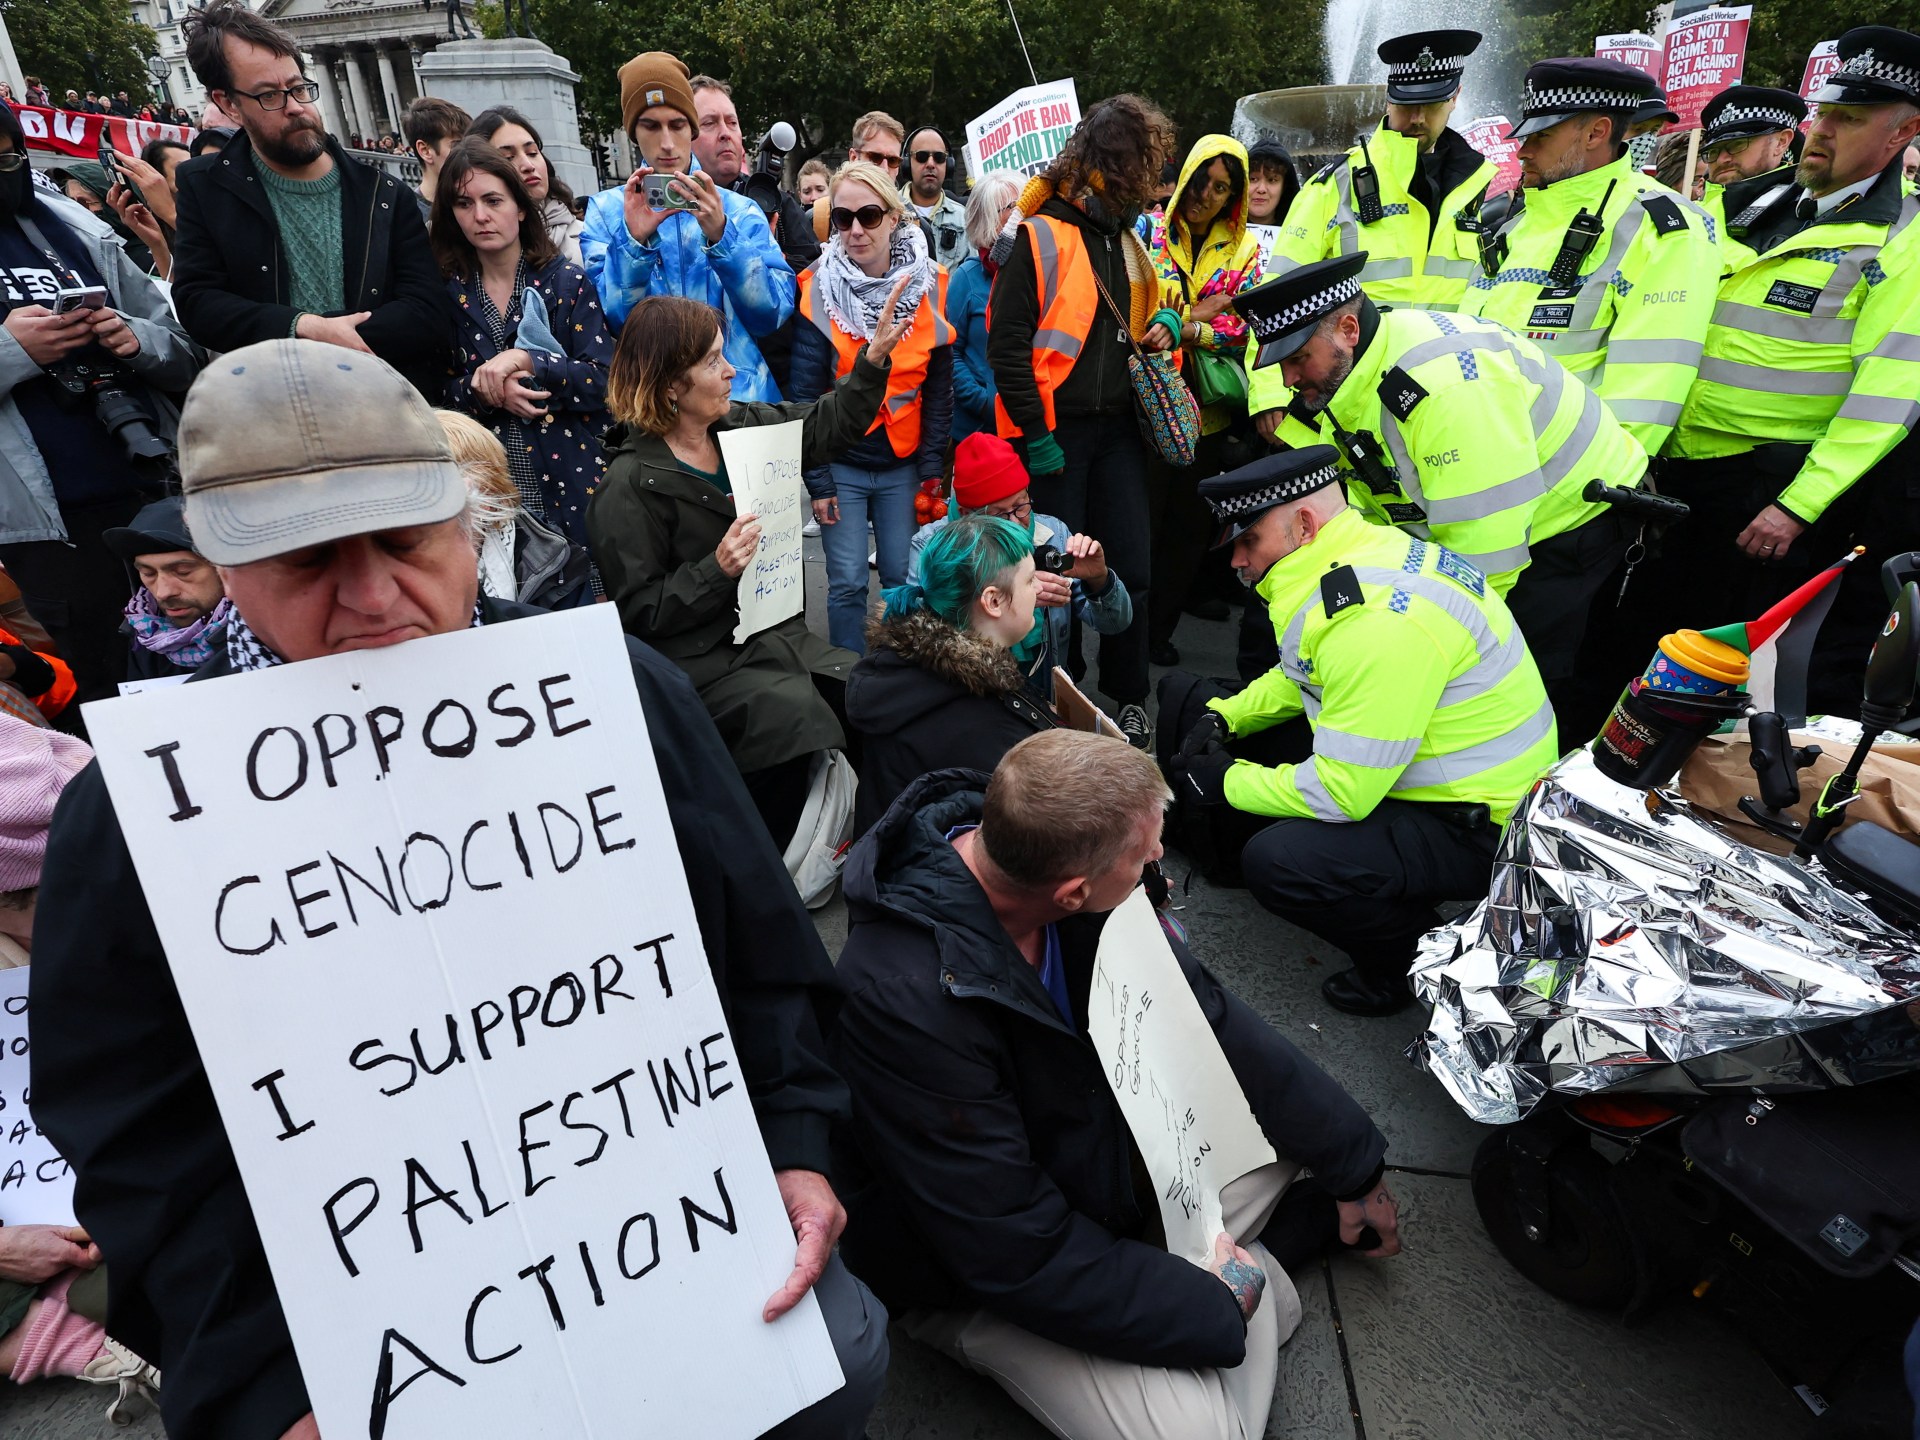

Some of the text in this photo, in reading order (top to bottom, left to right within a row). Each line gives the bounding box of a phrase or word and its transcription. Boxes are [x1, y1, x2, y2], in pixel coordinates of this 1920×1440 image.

[1679, 11, 1738, 28] Socialist Worker
[1609, 37, 1637, 47] Socialist
[1670, 23, 1729, 48] IT'S NOT A
[1624, 50, 1643, 67] NOT
[1643, 51, 1649, 67] A
[1669, 38, 1725, 63] CRIME TO
[1666, 61, 1692, 79] ACT
[1693, 53, 1738, 73] AGAINST
[1665, 69, 1722, 93] GENOCIDE
[1669, 90, 1713, 104] Free Palestine
[988, 93, 1067, 129] Stop the War coalition
[979, 121, 1012, 161] DROP
[1012, 109, 1039, 138] THE
[1039, 102, 1072, 129] BAN
[982, 132, 1043, 175] DEFEND
[1642, 290, 1687, 306] POLICE
[1768, 294, 1811, 310] POLICE OFFICER
[1398, 389, 1409, 402] AS
[1400, 391, 1418, 411] 2405
[763, 459, 800, 485] OPPOSE
[751, 493, 797, 519] GENOCIDE
[760, 524, 799, 552] SUPPORT
[755, 547, 801, 580] PALESTINE
[755, 572, 797, 602] ACTION
[143, 673, 592, 822] I OPPOSE
[215, 785, 636, 956] GENOCIDE
[252, 933, 675, 1142] I SUPPORT
[322, 1032, 734, 1278] PALESTINE
[368, 1167, 738, 1440] ACTION
